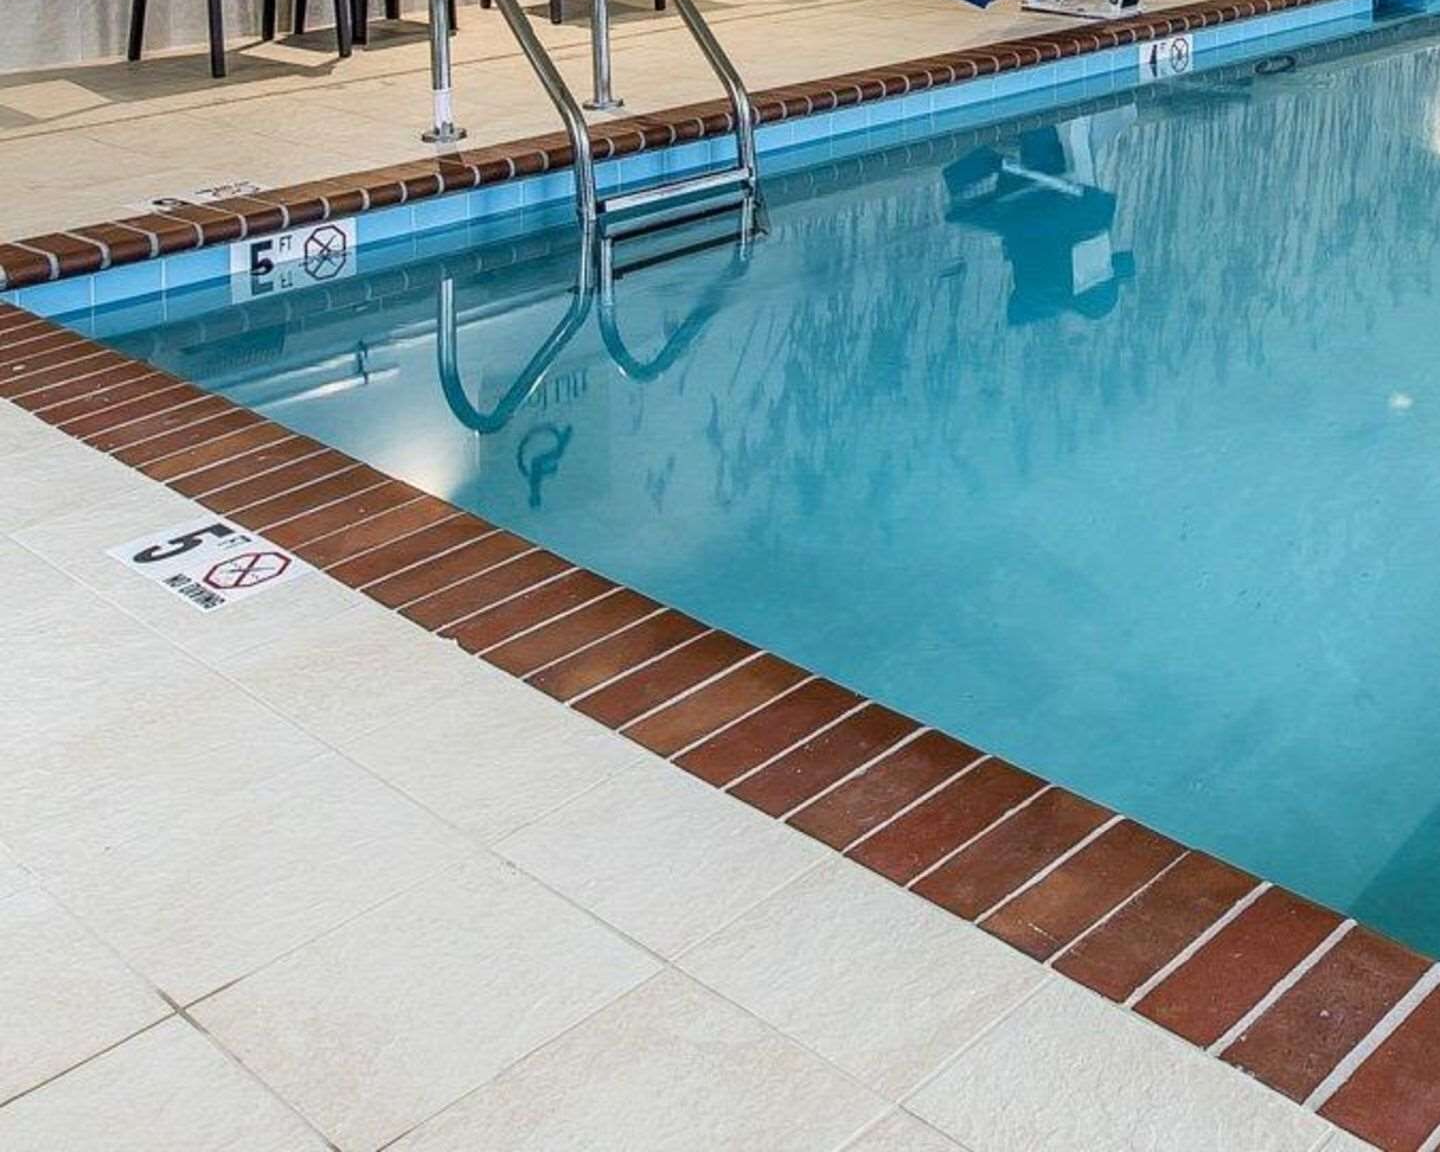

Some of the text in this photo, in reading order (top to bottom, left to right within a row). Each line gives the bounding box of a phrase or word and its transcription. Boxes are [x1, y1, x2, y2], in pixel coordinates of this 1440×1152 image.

[251, 234, 293, 276] 5 FT
[133, 524, 235, 563] 5
